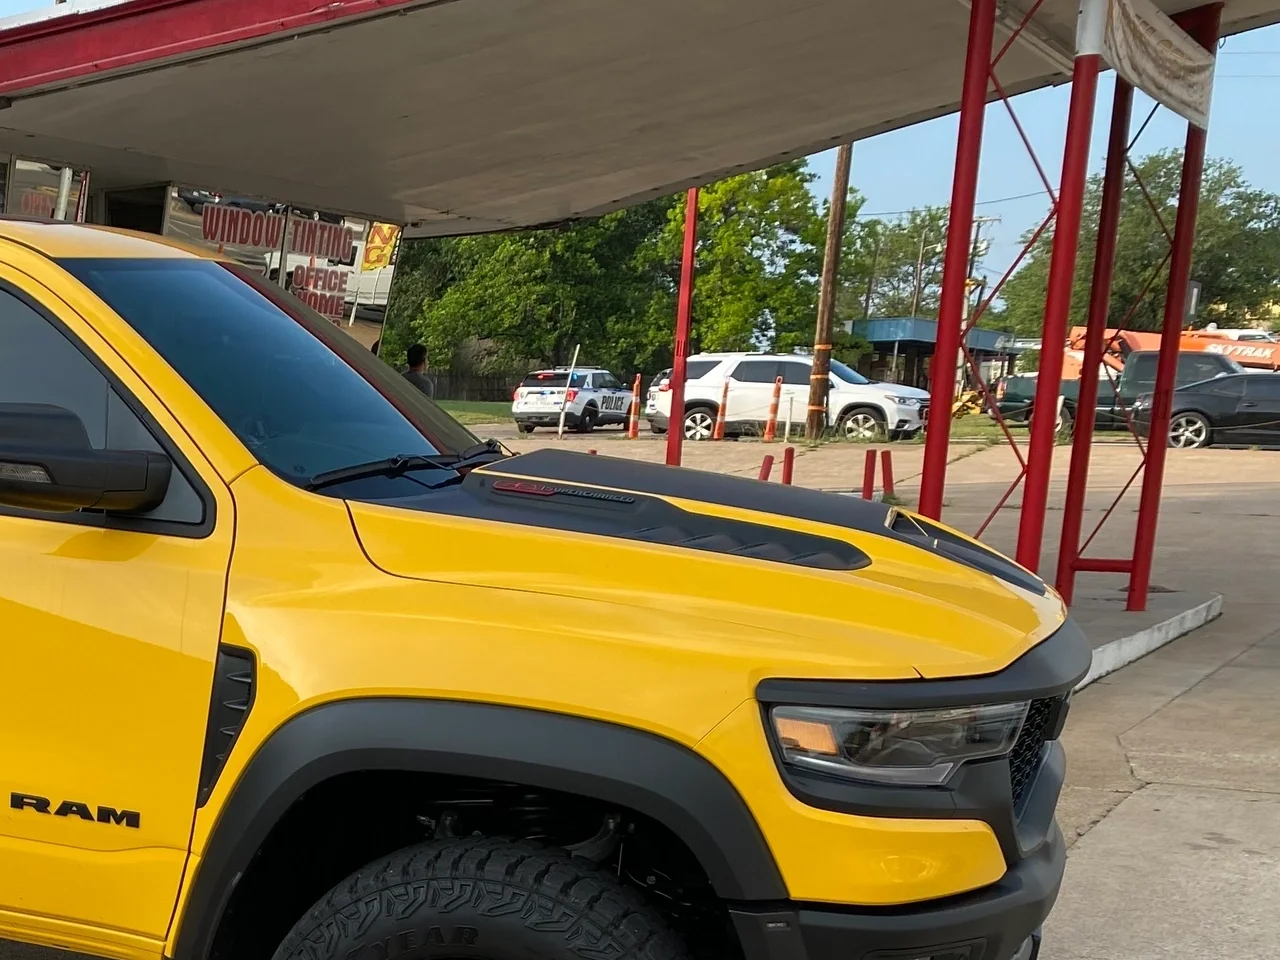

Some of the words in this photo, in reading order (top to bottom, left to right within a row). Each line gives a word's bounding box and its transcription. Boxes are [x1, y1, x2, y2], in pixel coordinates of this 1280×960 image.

[22, 192, 53, 214] OPEN
[202, 203, 282, 249] WINDOW
[291, 219, 354, 262] TINTING
[292, 264, 348, 292] OFFICE
[1204, 343, 1277, 359] SKYTRAK
[601, 395, 625, 411] POLICE
[10, 791, 141, 829] RAM
